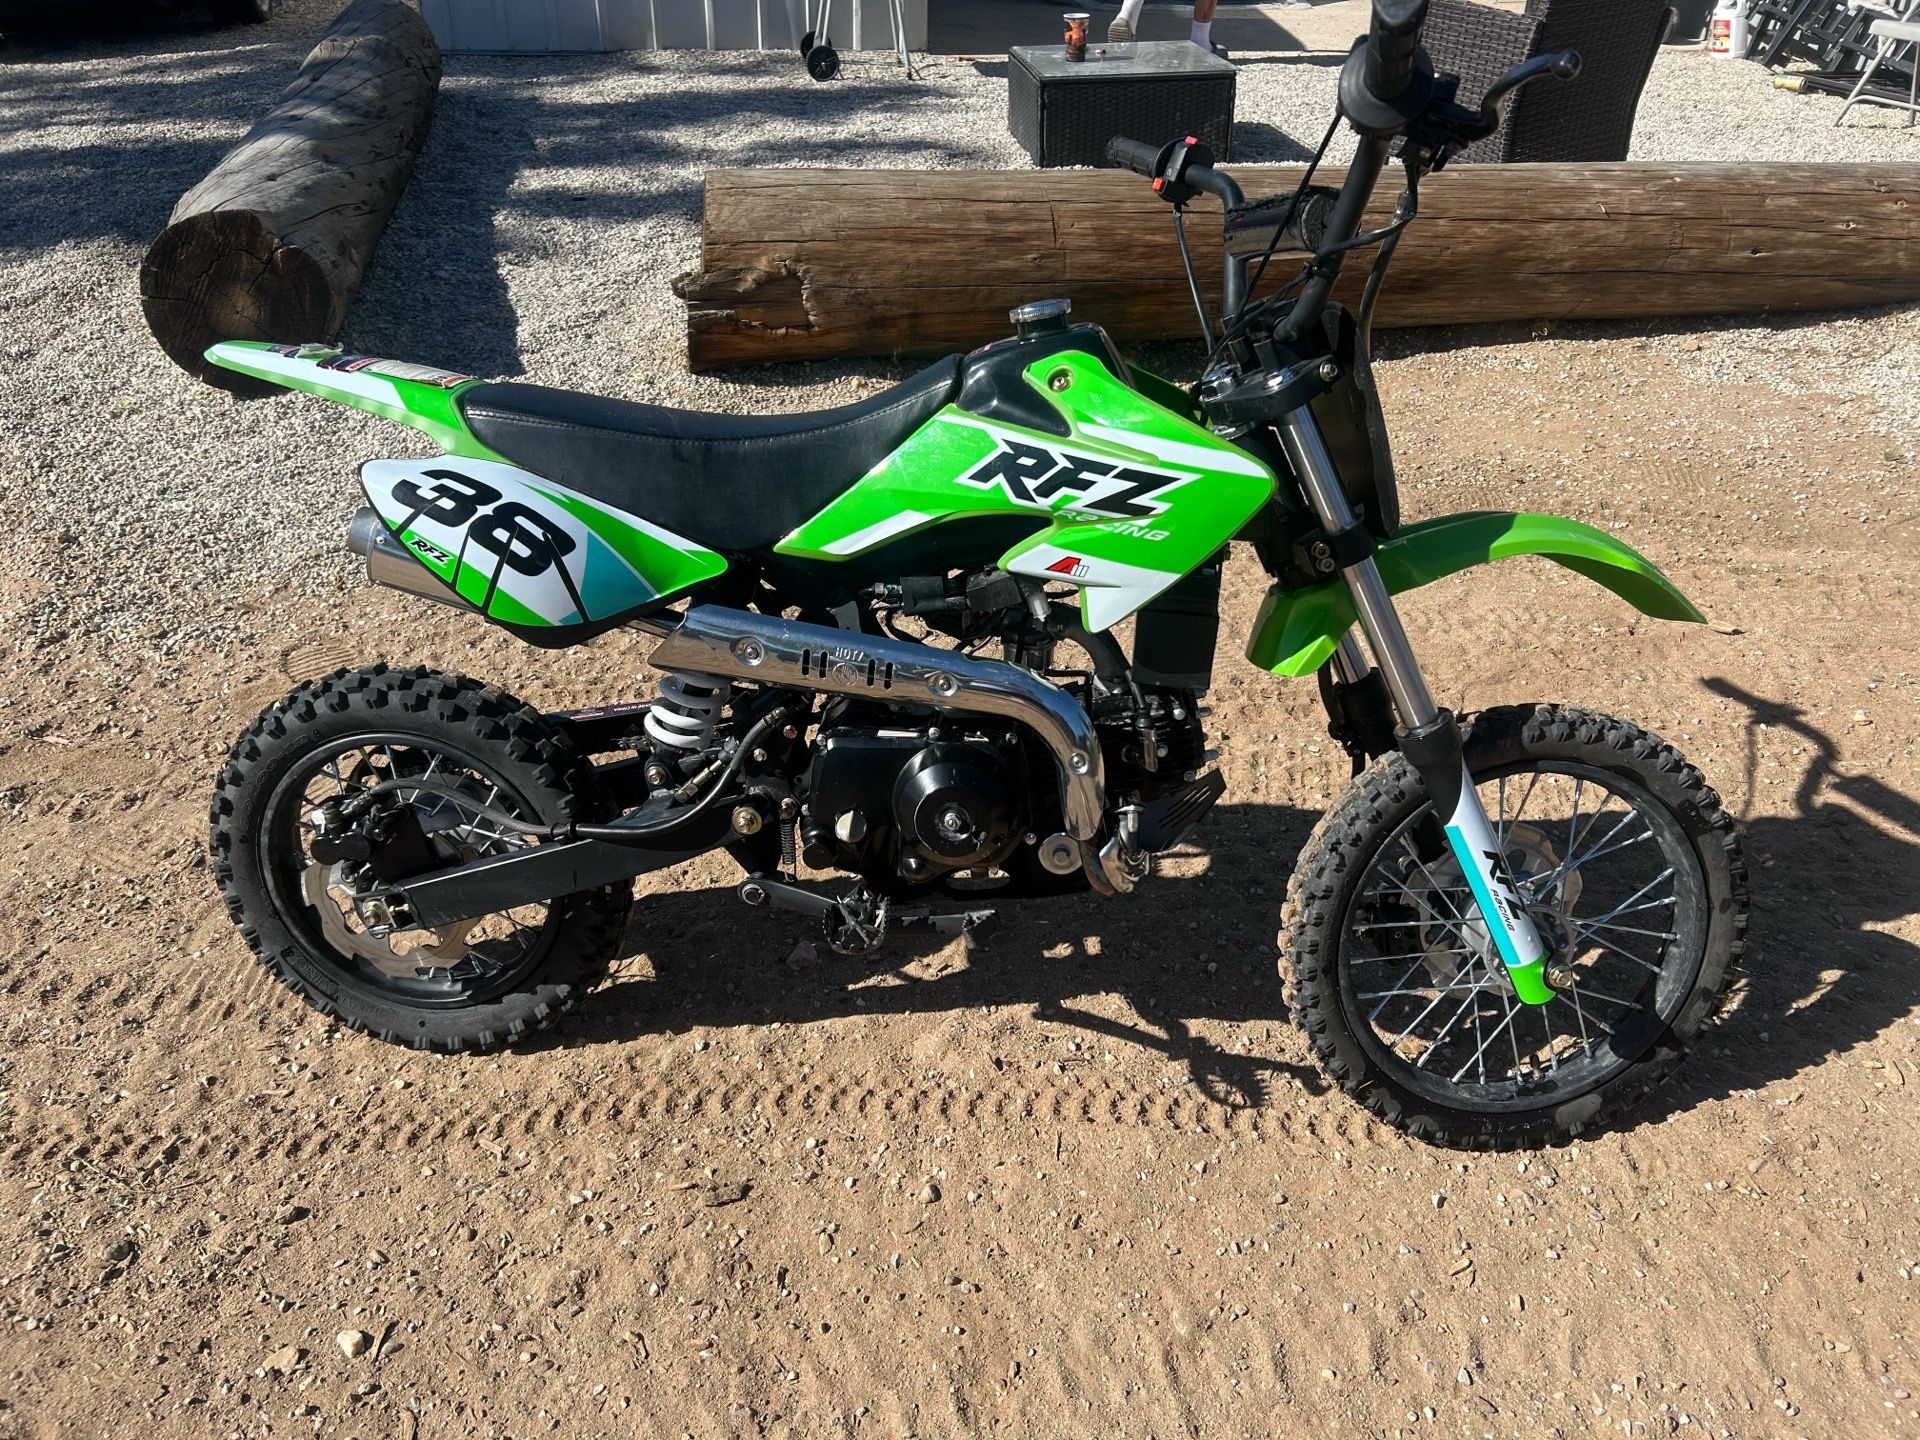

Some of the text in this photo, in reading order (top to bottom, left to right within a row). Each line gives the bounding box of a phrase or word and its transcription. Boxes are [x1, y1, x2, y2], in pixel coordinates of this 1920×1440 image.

[967, 438, 1182, 516] RFZ
[391, 469, 576, 577] 38
[410, 538, 450, 562] RFZ
